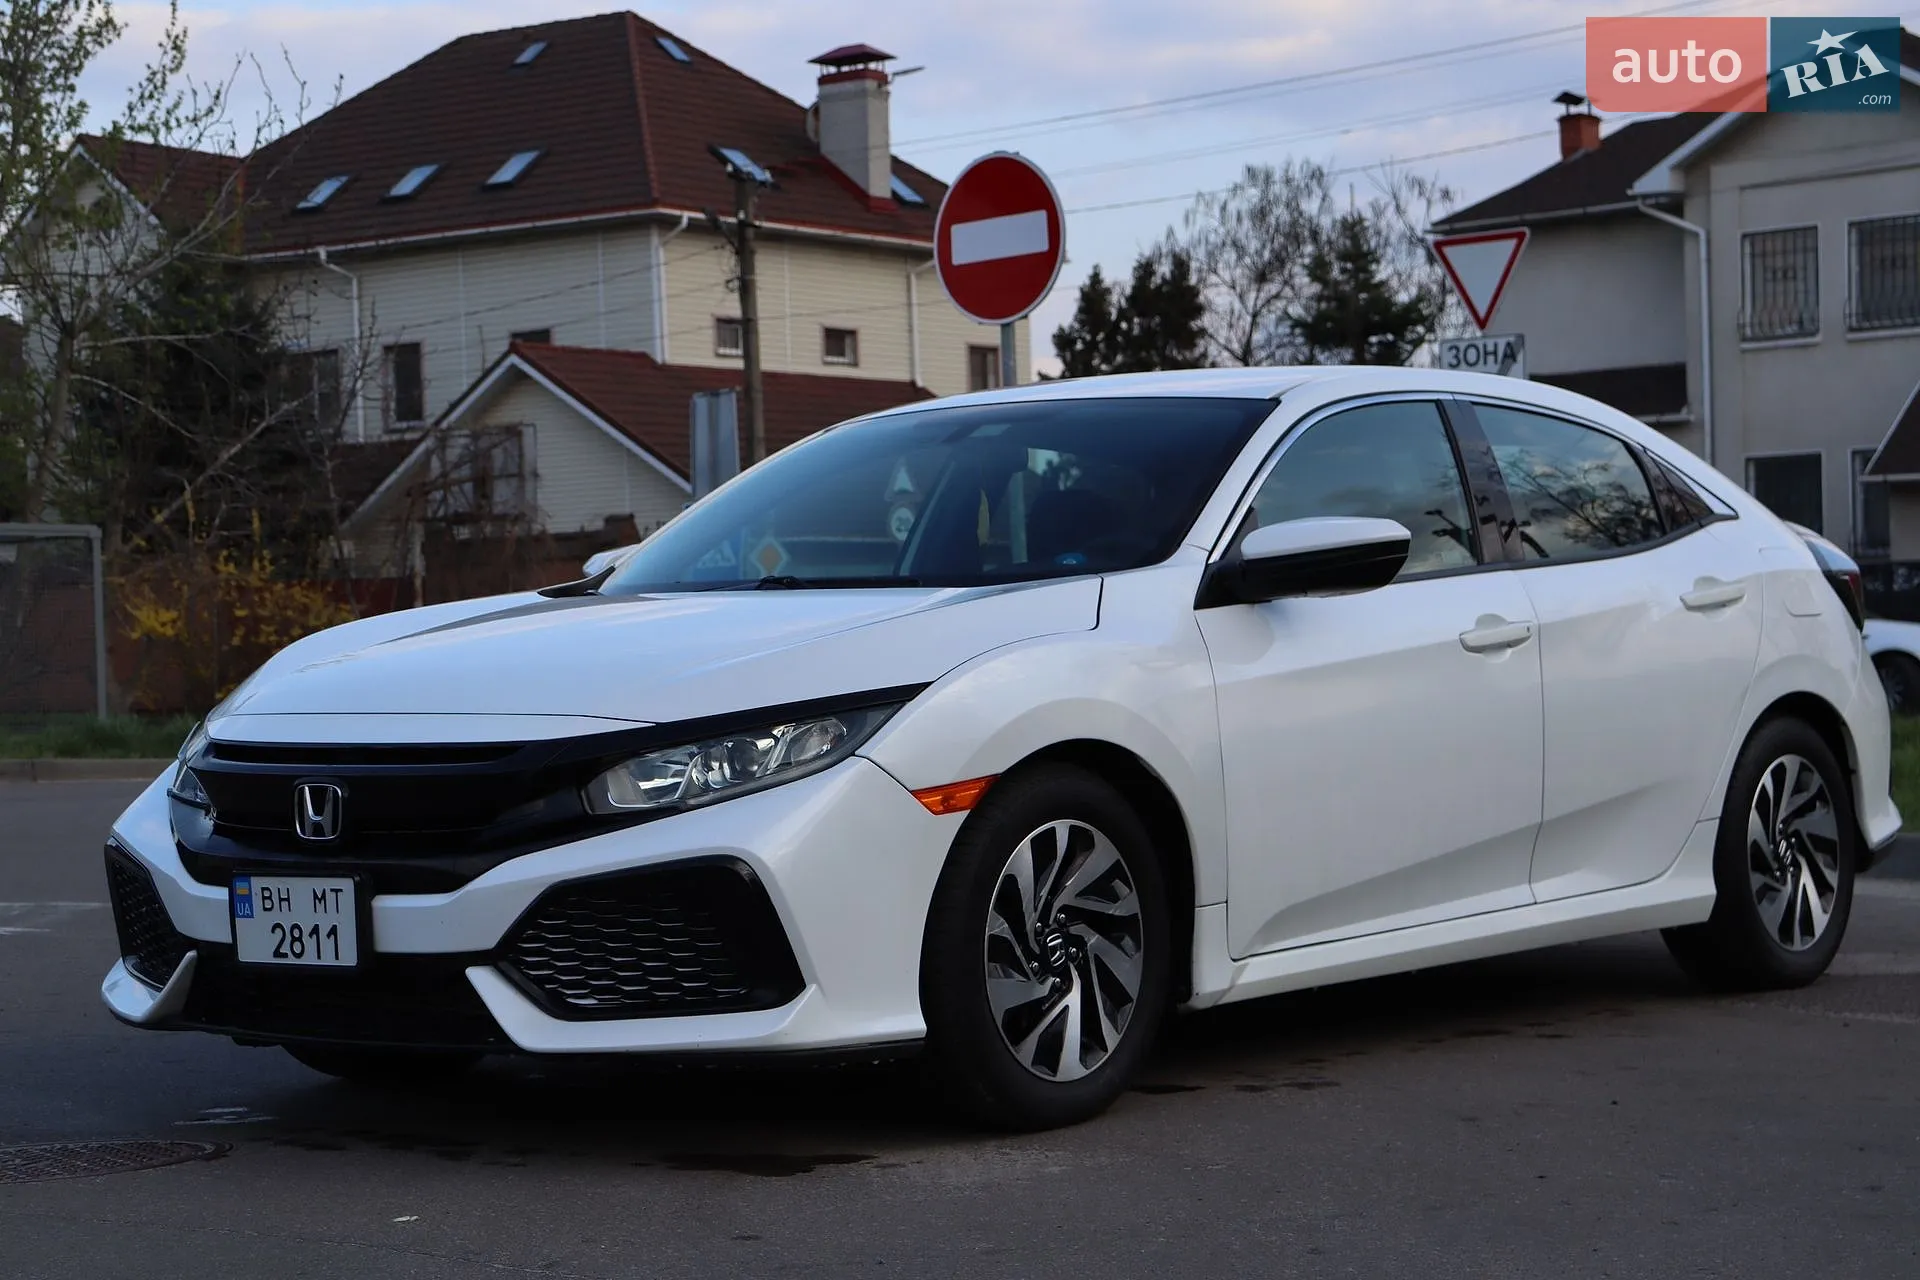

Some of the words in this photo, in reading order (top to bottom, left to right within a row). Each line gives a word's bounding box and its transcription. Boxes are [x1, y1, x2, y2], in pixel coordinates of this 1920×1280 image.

[1447, 341, 1517, 368] ЗОНА
[236, 902, 252, 916] UA
[261, 886, 291, 912] BH
[312, 888, 343, 914] MT
[271, 922, 339, 960] 2811
